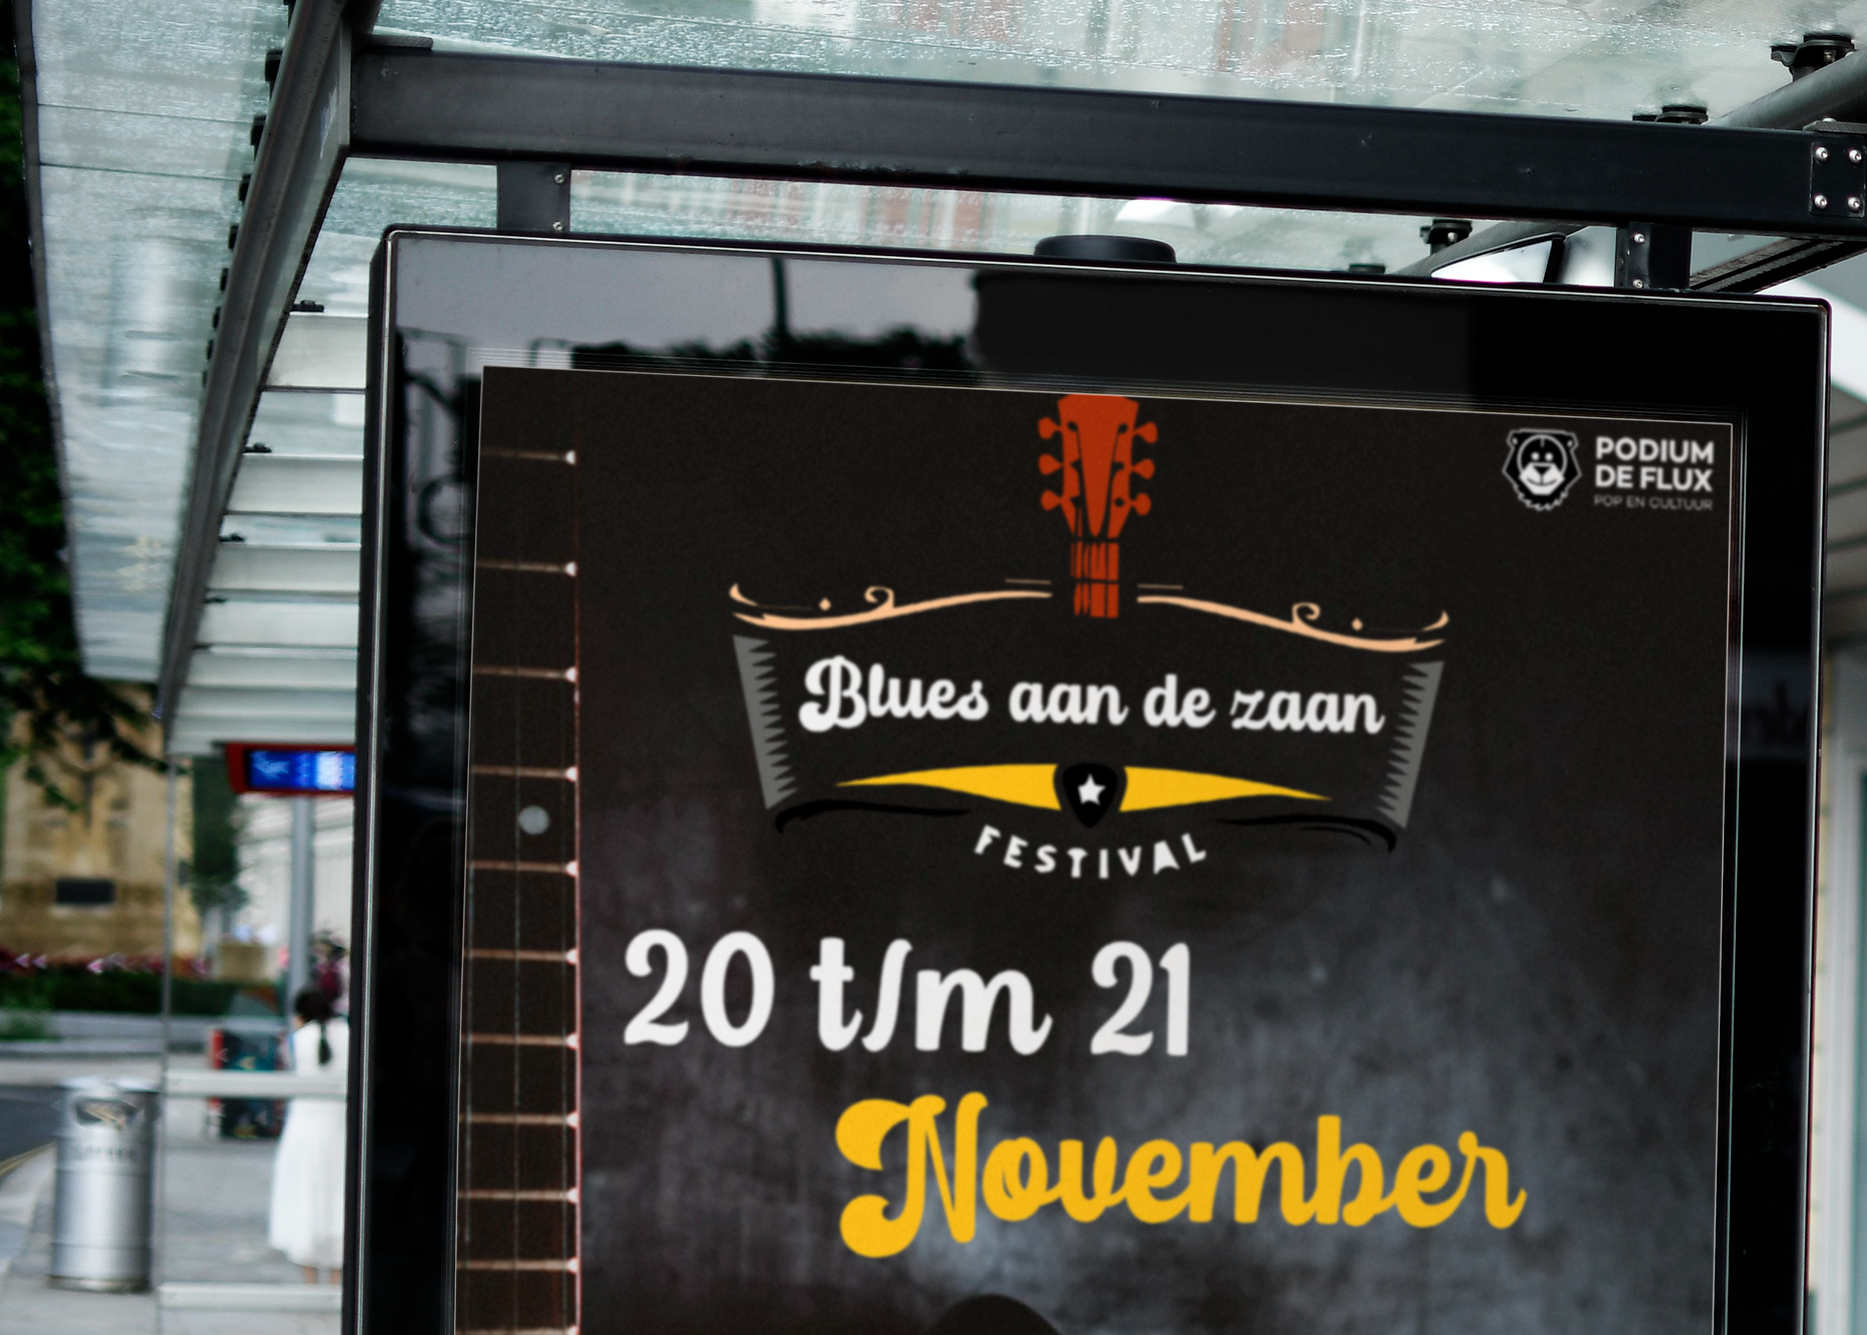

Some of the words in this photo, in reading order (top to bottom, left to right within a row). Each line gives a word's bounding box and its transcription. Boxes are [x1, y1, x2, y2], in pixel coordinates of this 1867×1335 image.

[1596, 436, 1714, 464] PODIUM
[1593, 494, 1623, 507] POP
[1625, 495, 1646, 509] EN
[1649, 496, 1713, 511] CULTUUR
[1595, 464, 1634, 489] DE
[1640, 466, 1712, 492] FLUX
[798, 655, 989, 732] Blues
[1009, 682, 1129, 725] aan
[1143, 673, 1216, 728] de
[1230, 690, 1385, 734] zaan
[974, 825, 1206, 879] FESTIVAL
[624, 929, 775, 1047] 20
[1090, 941, 1190, 1057] 21
[835, 1092, 1527, 1258] November
